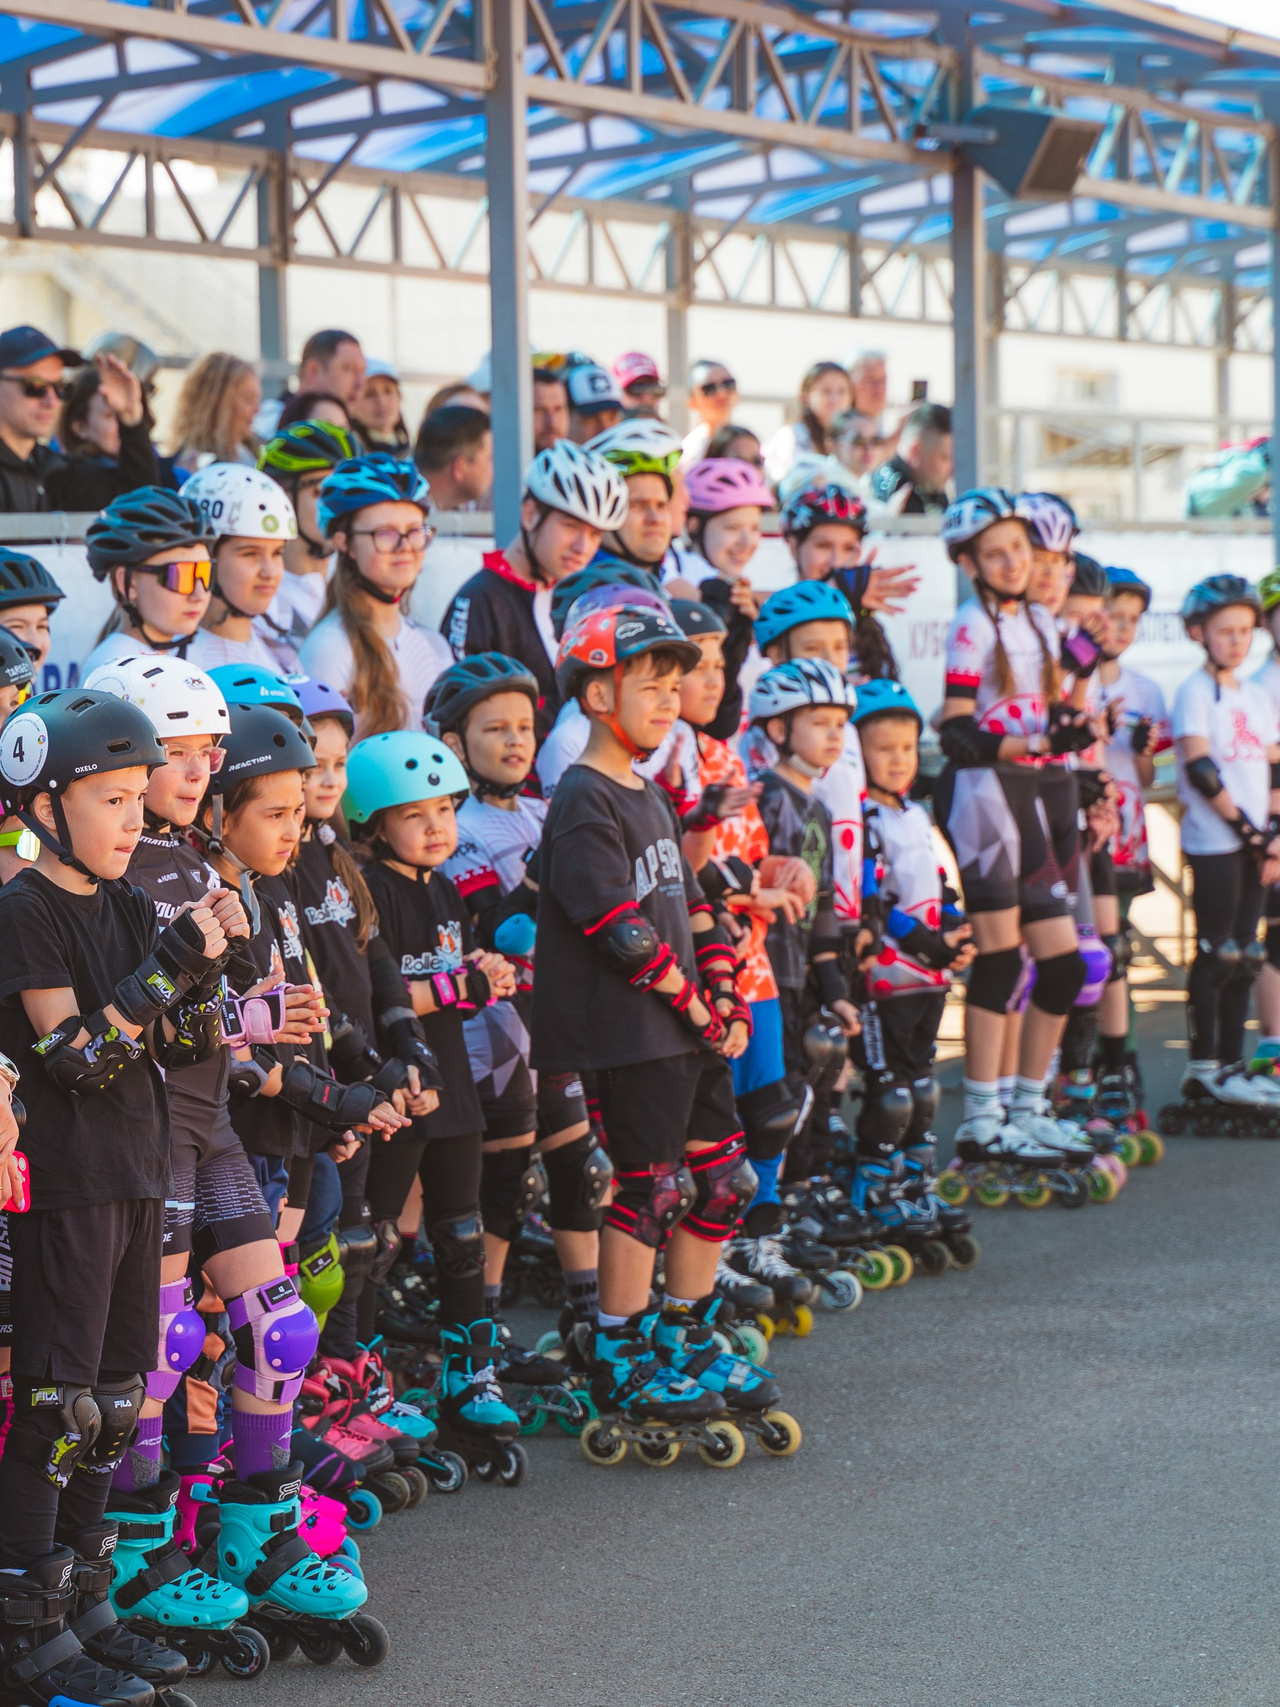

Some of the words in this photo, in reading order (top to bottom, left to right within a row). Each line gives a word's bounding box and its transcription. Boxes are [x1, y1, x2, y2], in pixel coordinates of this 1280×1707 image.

[12, 736, 25, 763] 4
[74, 763, 98, 774] OXELO
[228, 754, 272, 772] REACTION
[38, 1032, 62, 1050] FILA
[36, 1392, 59, 1401] FILA
[114, 1400, 133, 1409] FILA
